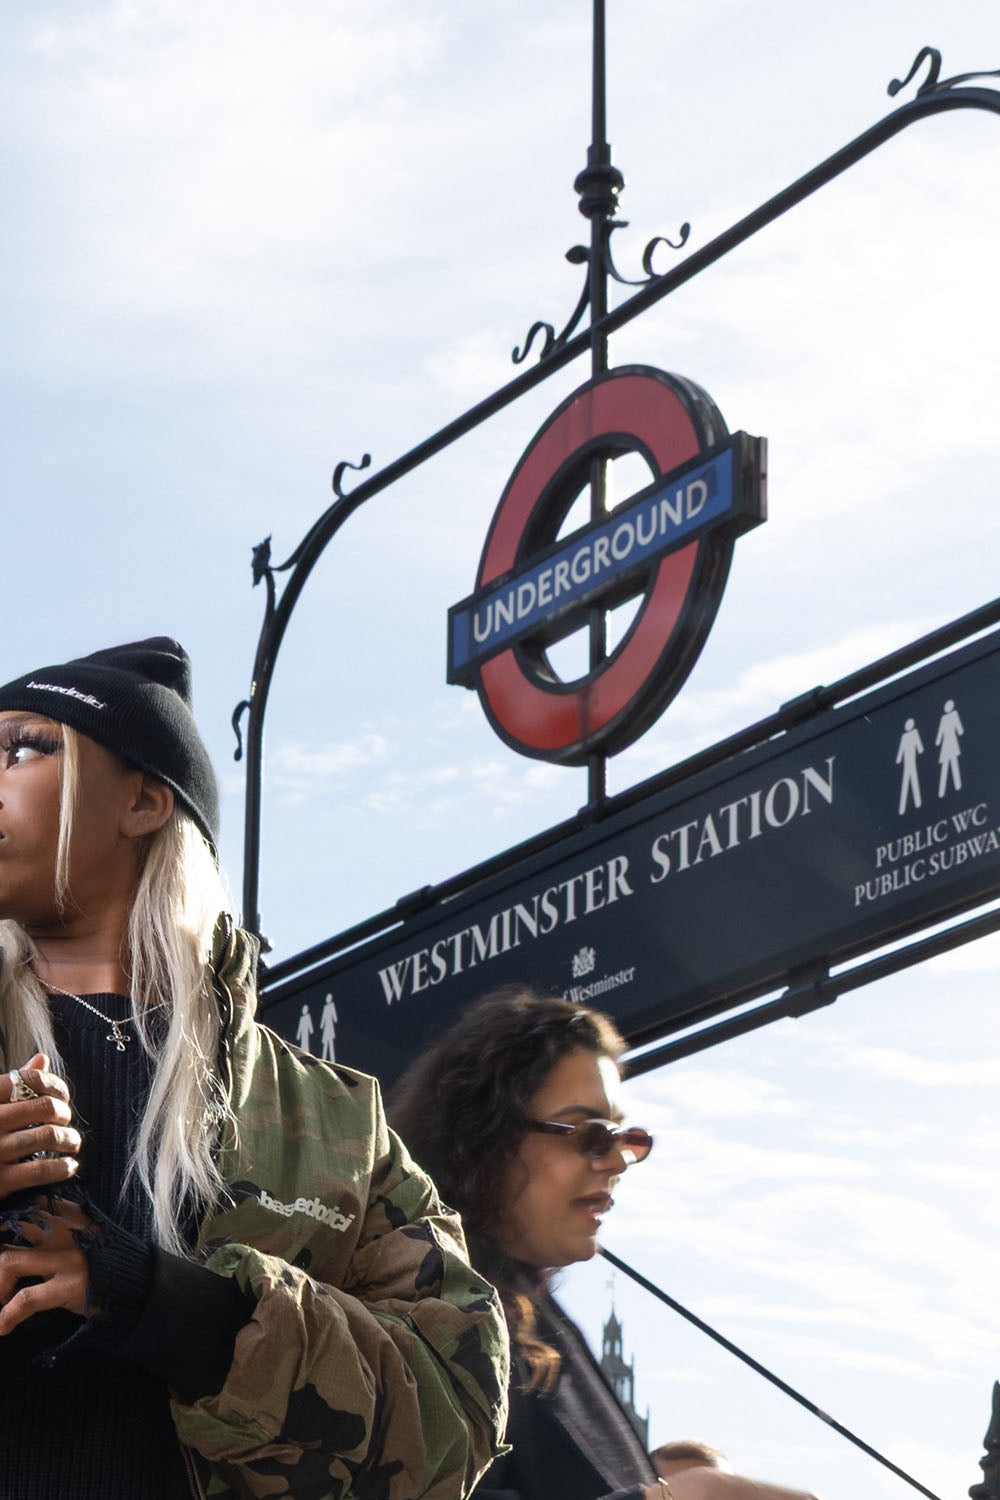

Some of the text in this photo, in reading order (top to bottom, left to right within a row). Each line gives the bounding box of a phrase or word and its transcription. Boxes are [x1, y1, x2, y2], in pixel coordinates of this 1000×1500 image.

[473, 480, 708, 643] UNDERGROUND
[854, 827, 1000, 906] PUBLIC SUBWA
[876, 803, 988, 868] PUBLIC WC
[377, 756, 837, 1006] WESTMINSTER STATION
[569, 967, 636, 1003] Westminster
